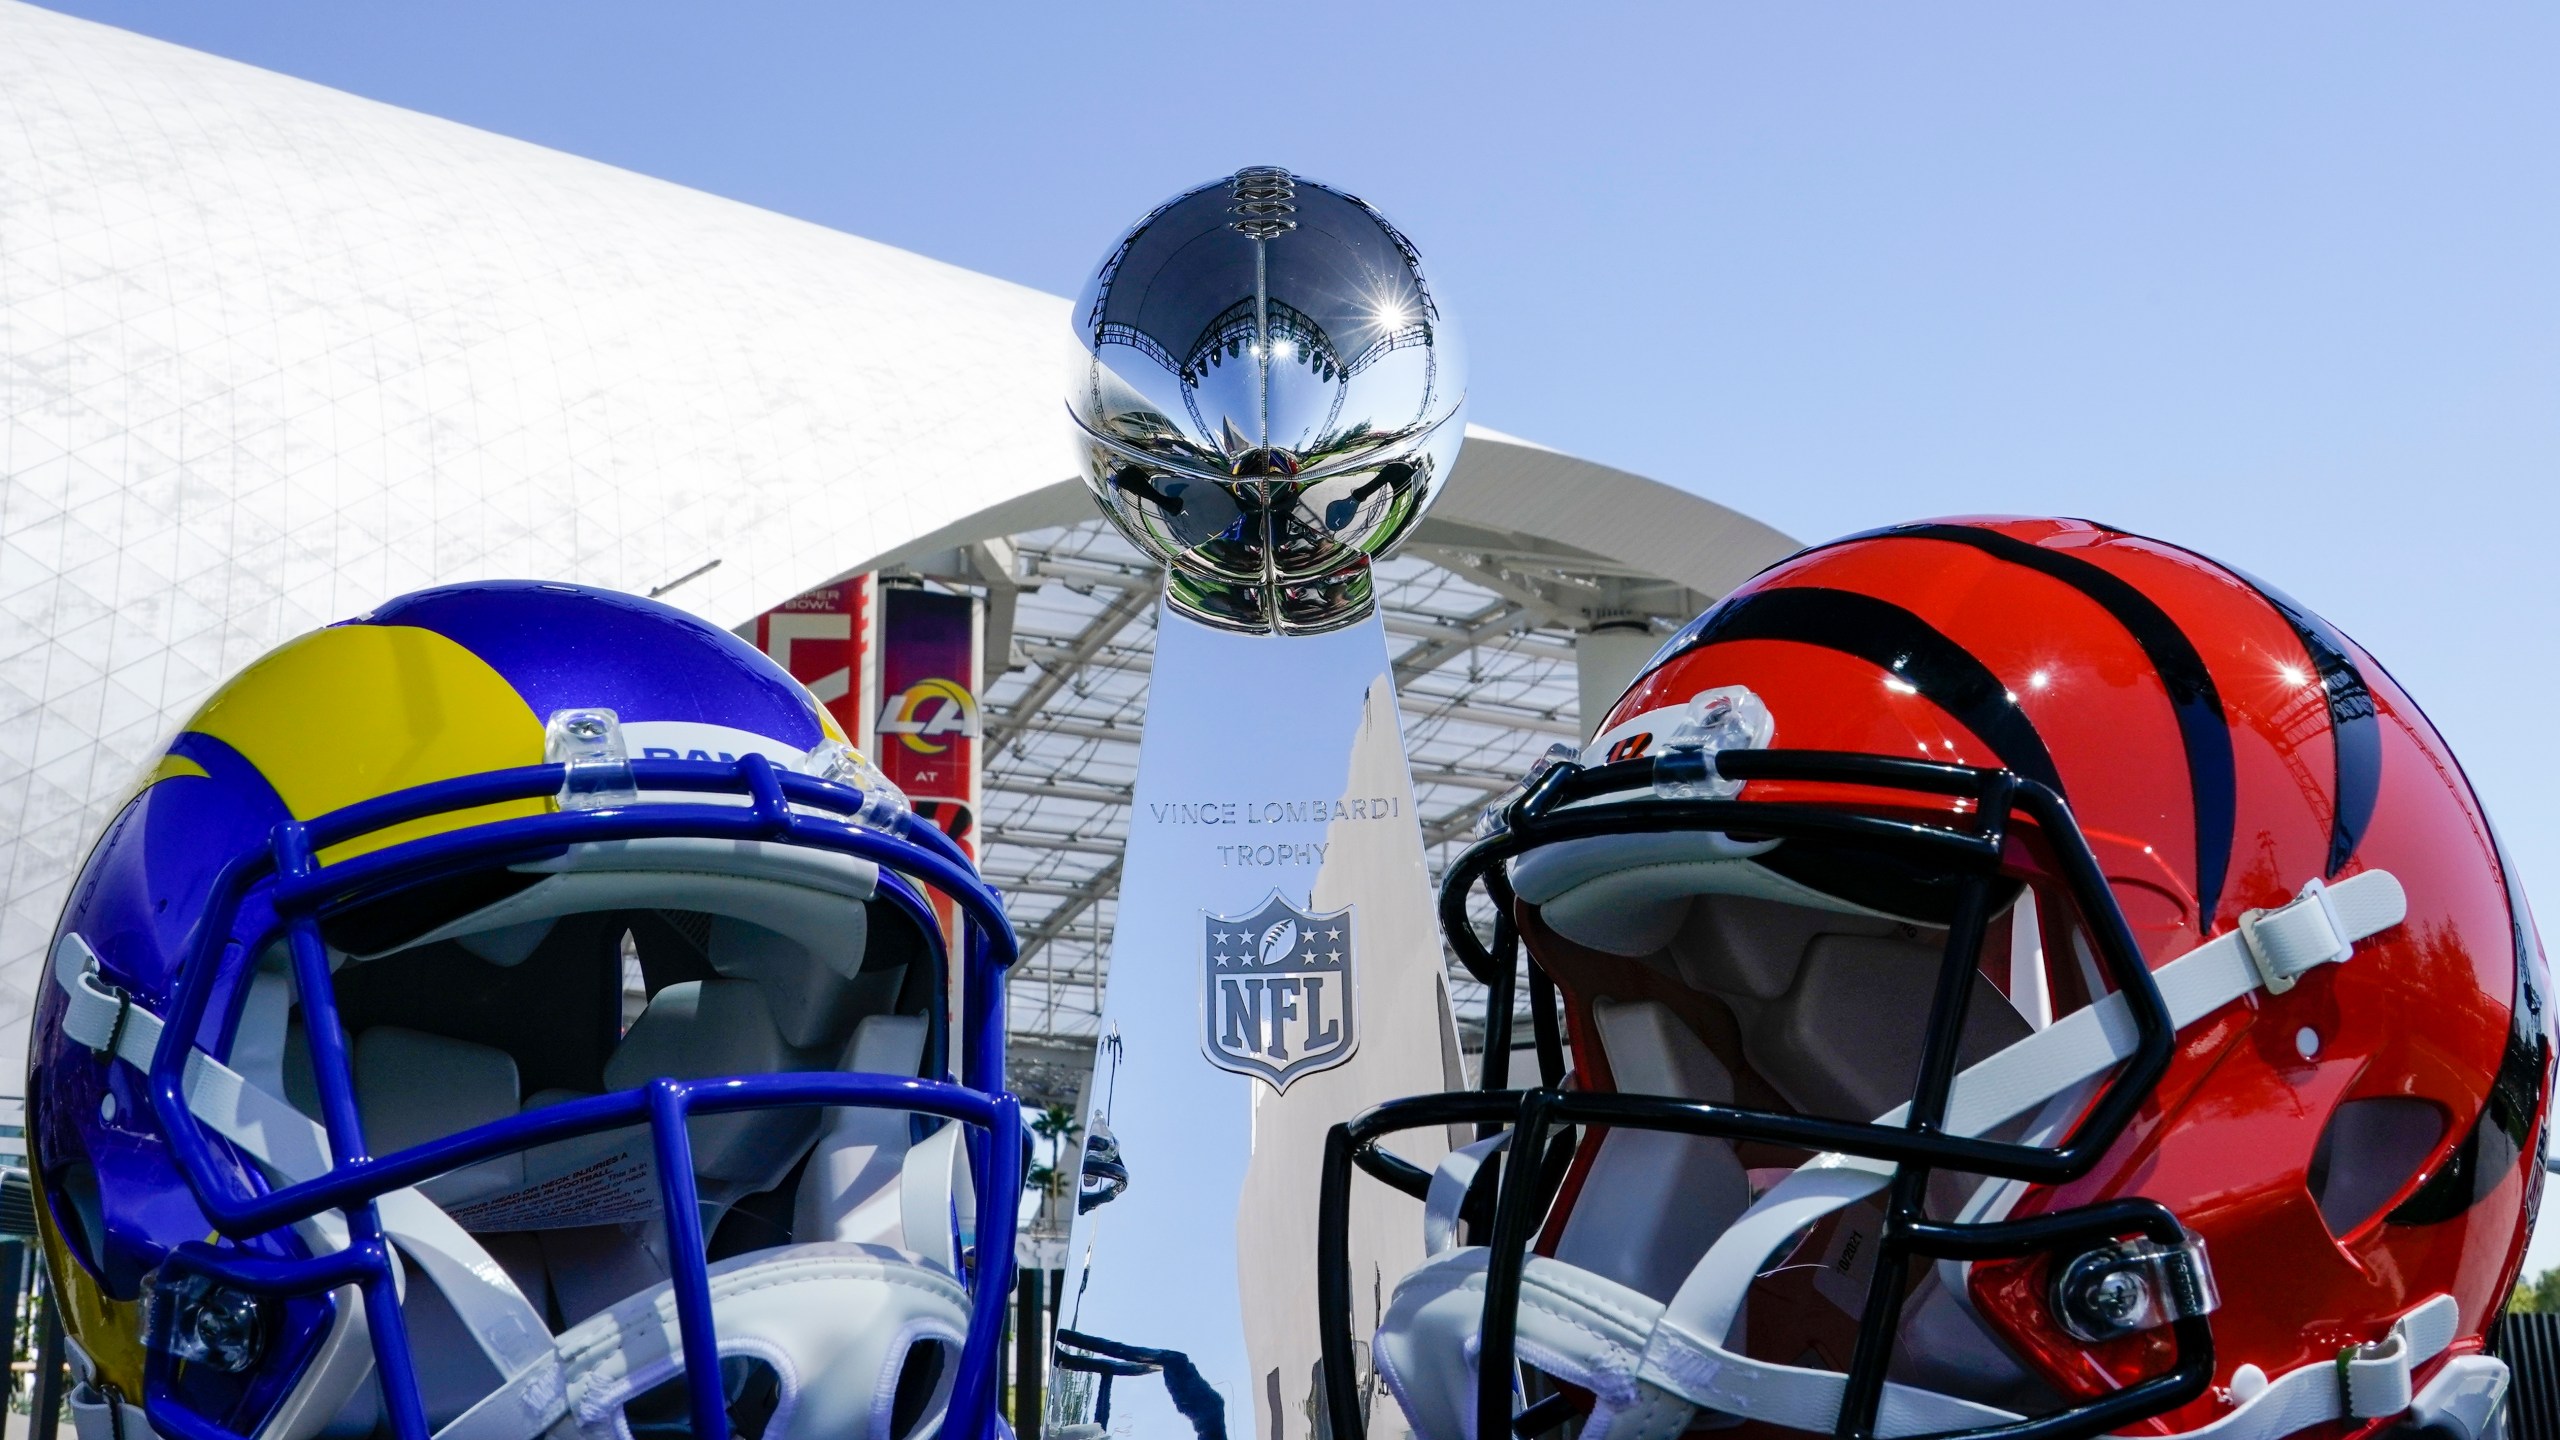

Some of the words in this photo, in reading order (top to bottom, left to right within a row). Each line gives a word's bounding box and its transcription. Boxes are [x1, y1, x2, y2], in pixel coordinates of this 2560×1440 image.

[785, 600, 836, 610] BOWL
[915, 771, 938, 782] AT
[1150, 803, 1236, 825] VINCE
[1248, 797, 1399, 824] LOMBARDI
[1217, 842, 1330, 867] TROPHY
[1221, 978, 1339, 1061] NFL
[491, 1192, 520, 1205] HEAD
[522, 1186, 539, 1196] OR
[541, 1175, 570, 1189] NECK
[573, 1157, 619, 1179] INJURIES
[620, 1152, 629, 1160] A
[607, 1170, 627, 1181] This
[639, 1162, 648, 1170] in
[624, 1170, 647, 1182] neck
[462, 1193, 541, 1217] PARTICIPATING
[543, 1188, 555, 1196] IN
[560, 1200, 601, 1214] INJURY
